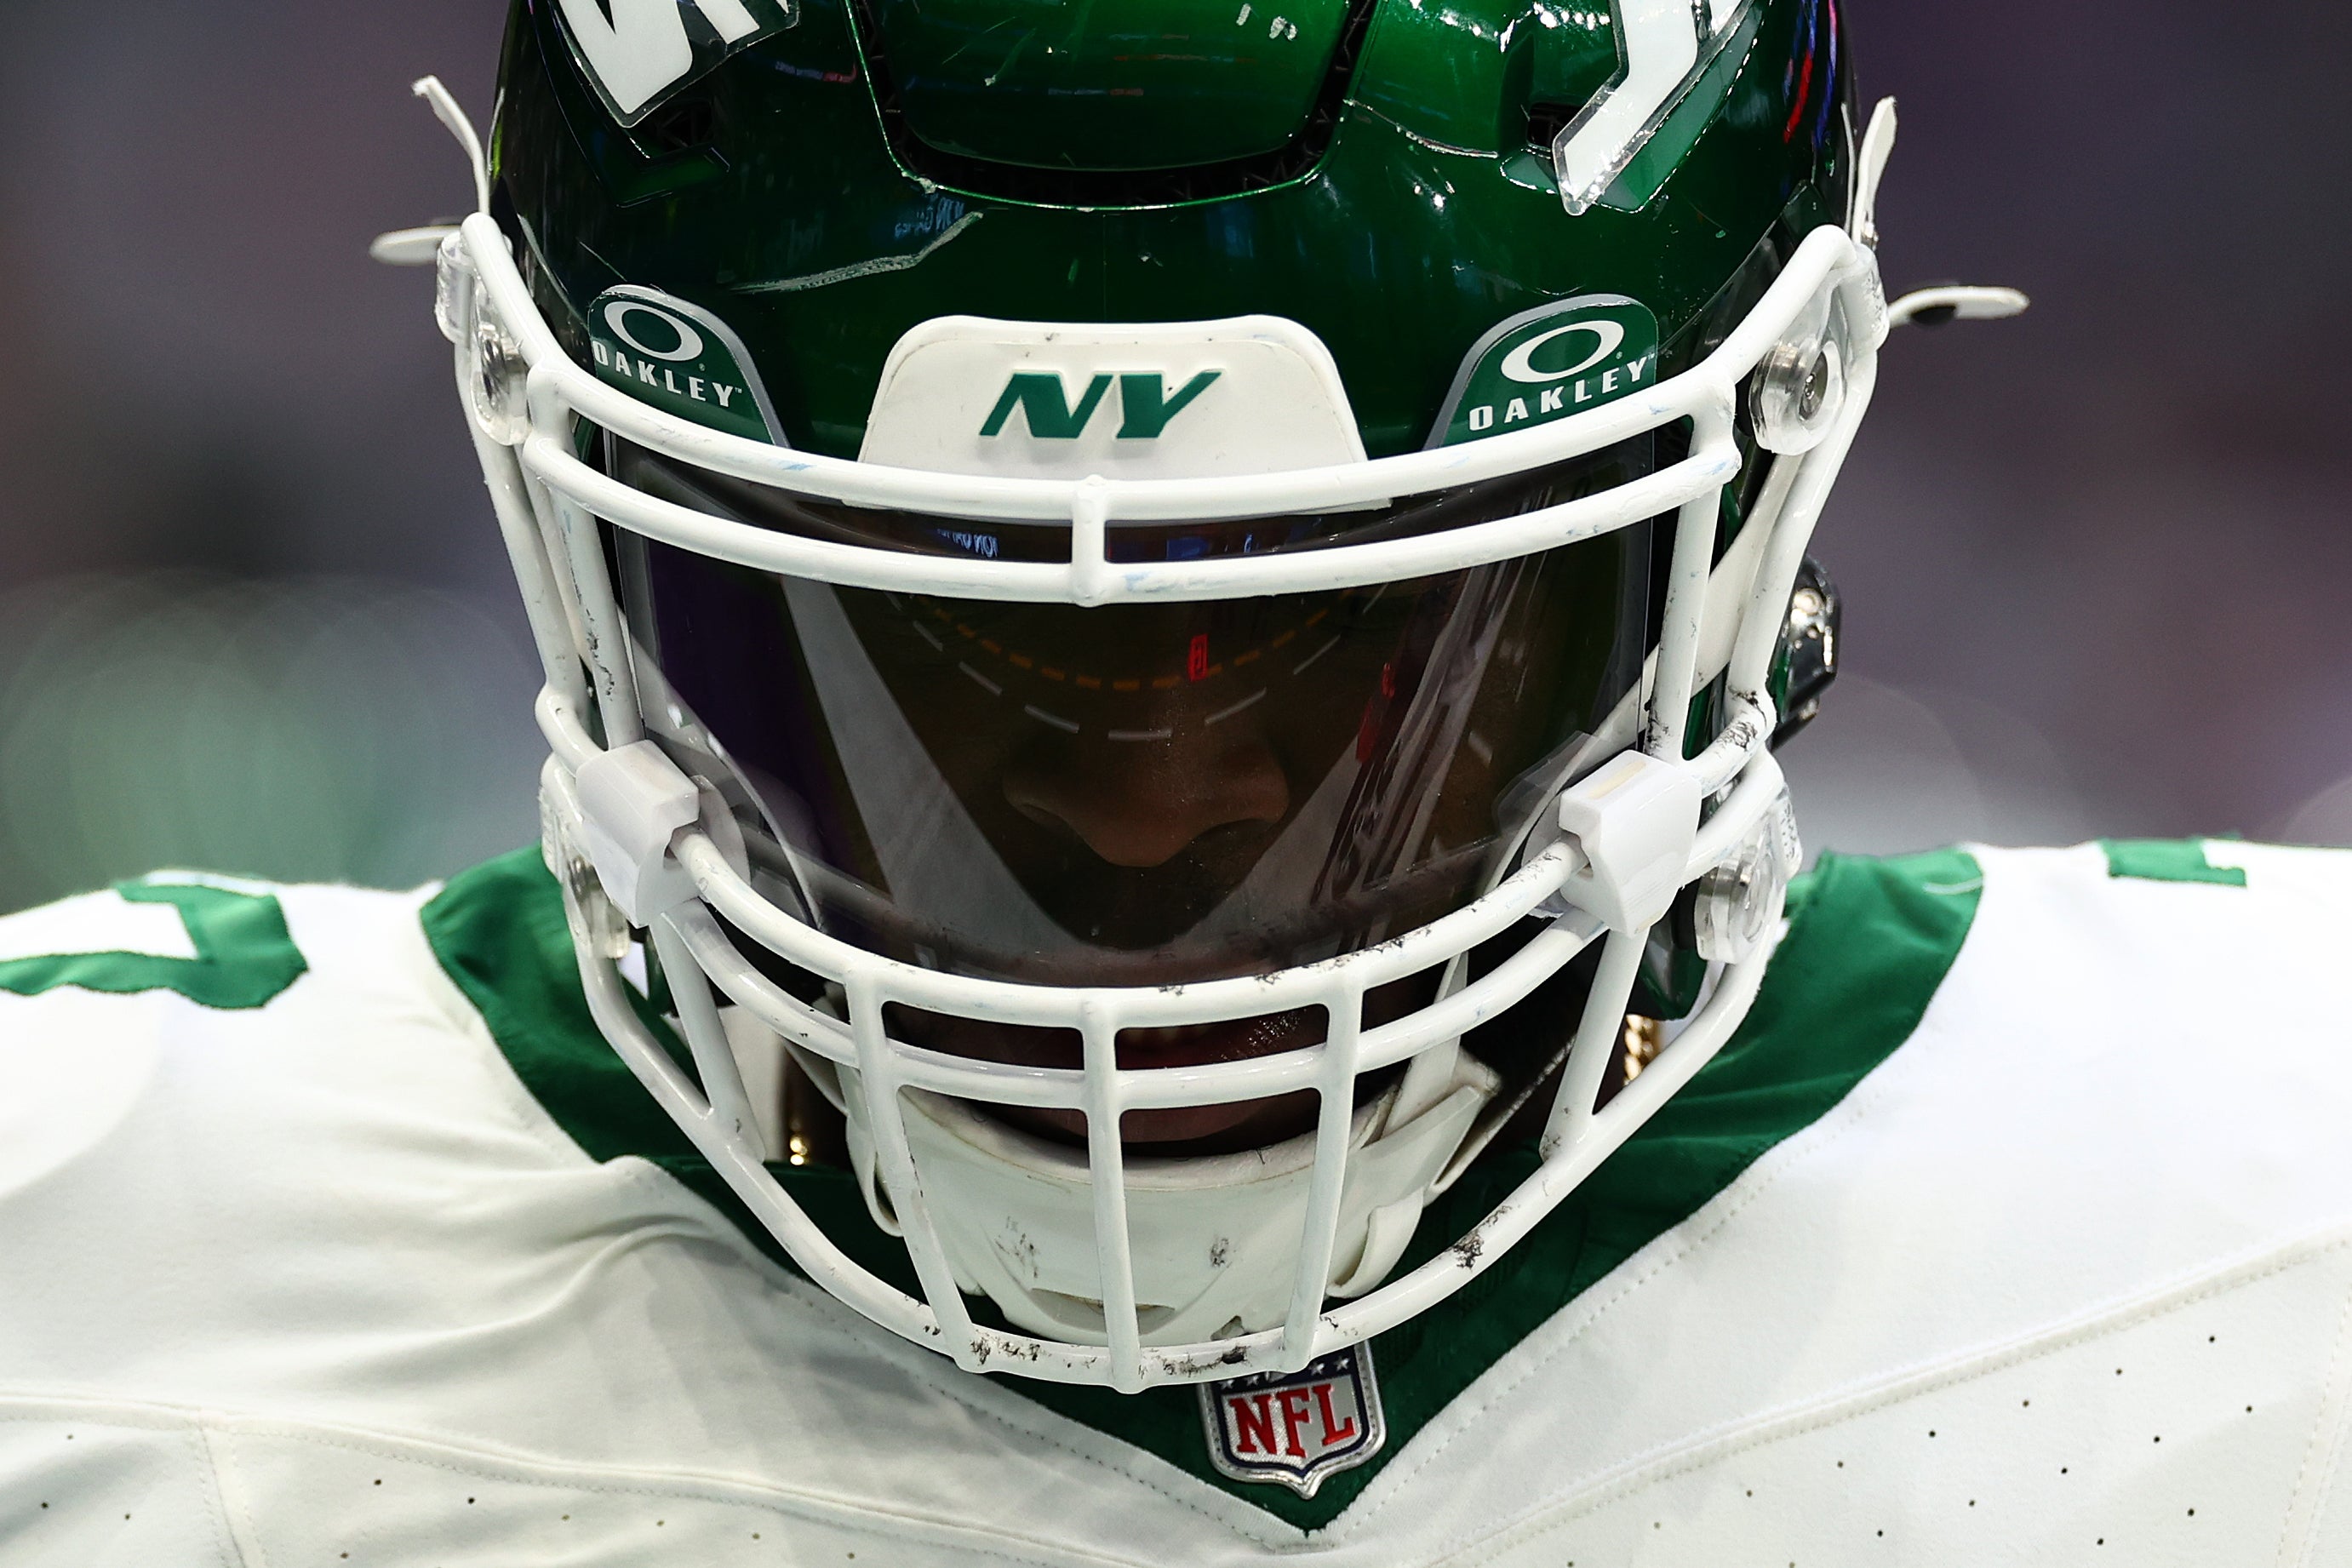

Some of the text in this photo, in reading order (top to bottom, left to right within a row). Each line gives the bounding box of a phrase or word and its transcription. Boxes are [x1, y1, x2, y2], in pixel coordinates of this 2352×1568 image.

[592, 340, 734, 408] OAKLEY
[979, 371, 1222, 439] NY
[1468, 356, 1647, 432] OAKLEY
[1228, 1382, 1356, 1458] NFL
